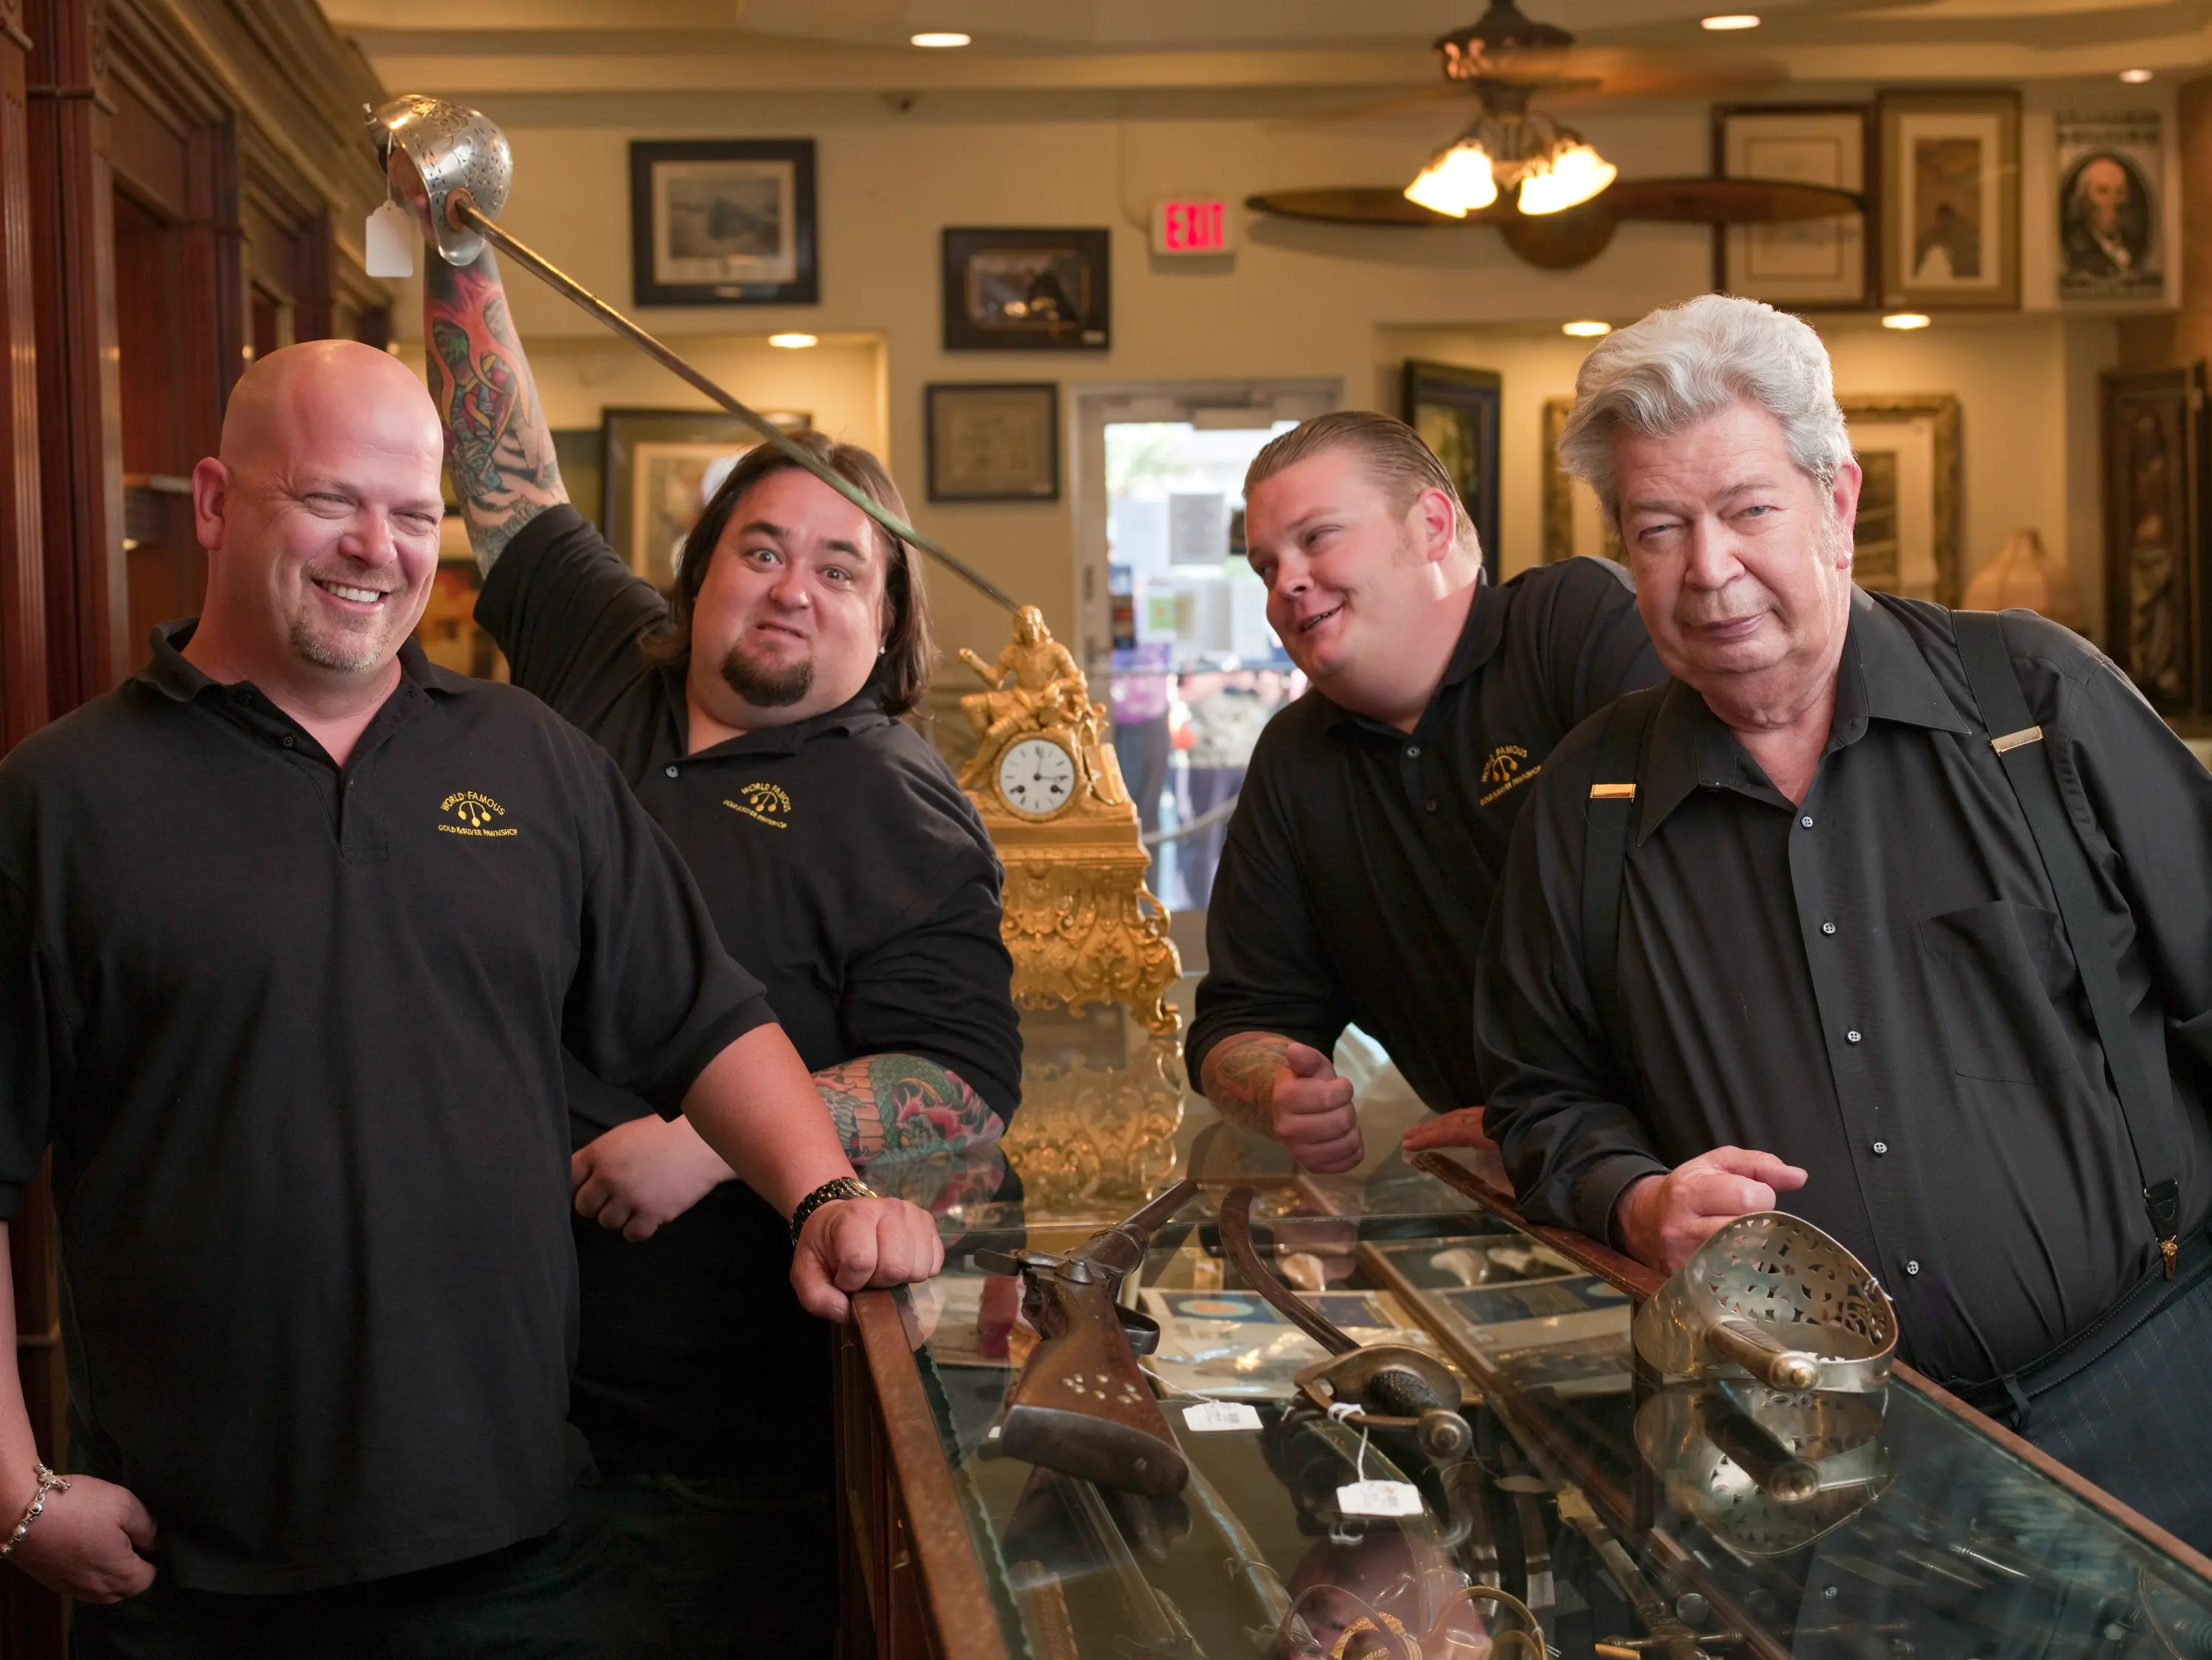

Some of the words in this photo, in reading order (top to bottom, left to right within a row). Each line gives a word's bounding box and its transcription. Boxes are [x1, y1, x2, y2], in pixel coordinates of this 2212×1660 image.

[1165, 202, 1225, 250] EXIT
[1495, 745, 1527, 758] FAMOUS
[440, 792, 465, 812] WORLD
[467, 791, 506, 816] FAMOUS
[740, 782, 771, 795] WORLD
[771, 785, 792, 813] FAMOUS
[438, 824, 456, 833] GOLD
